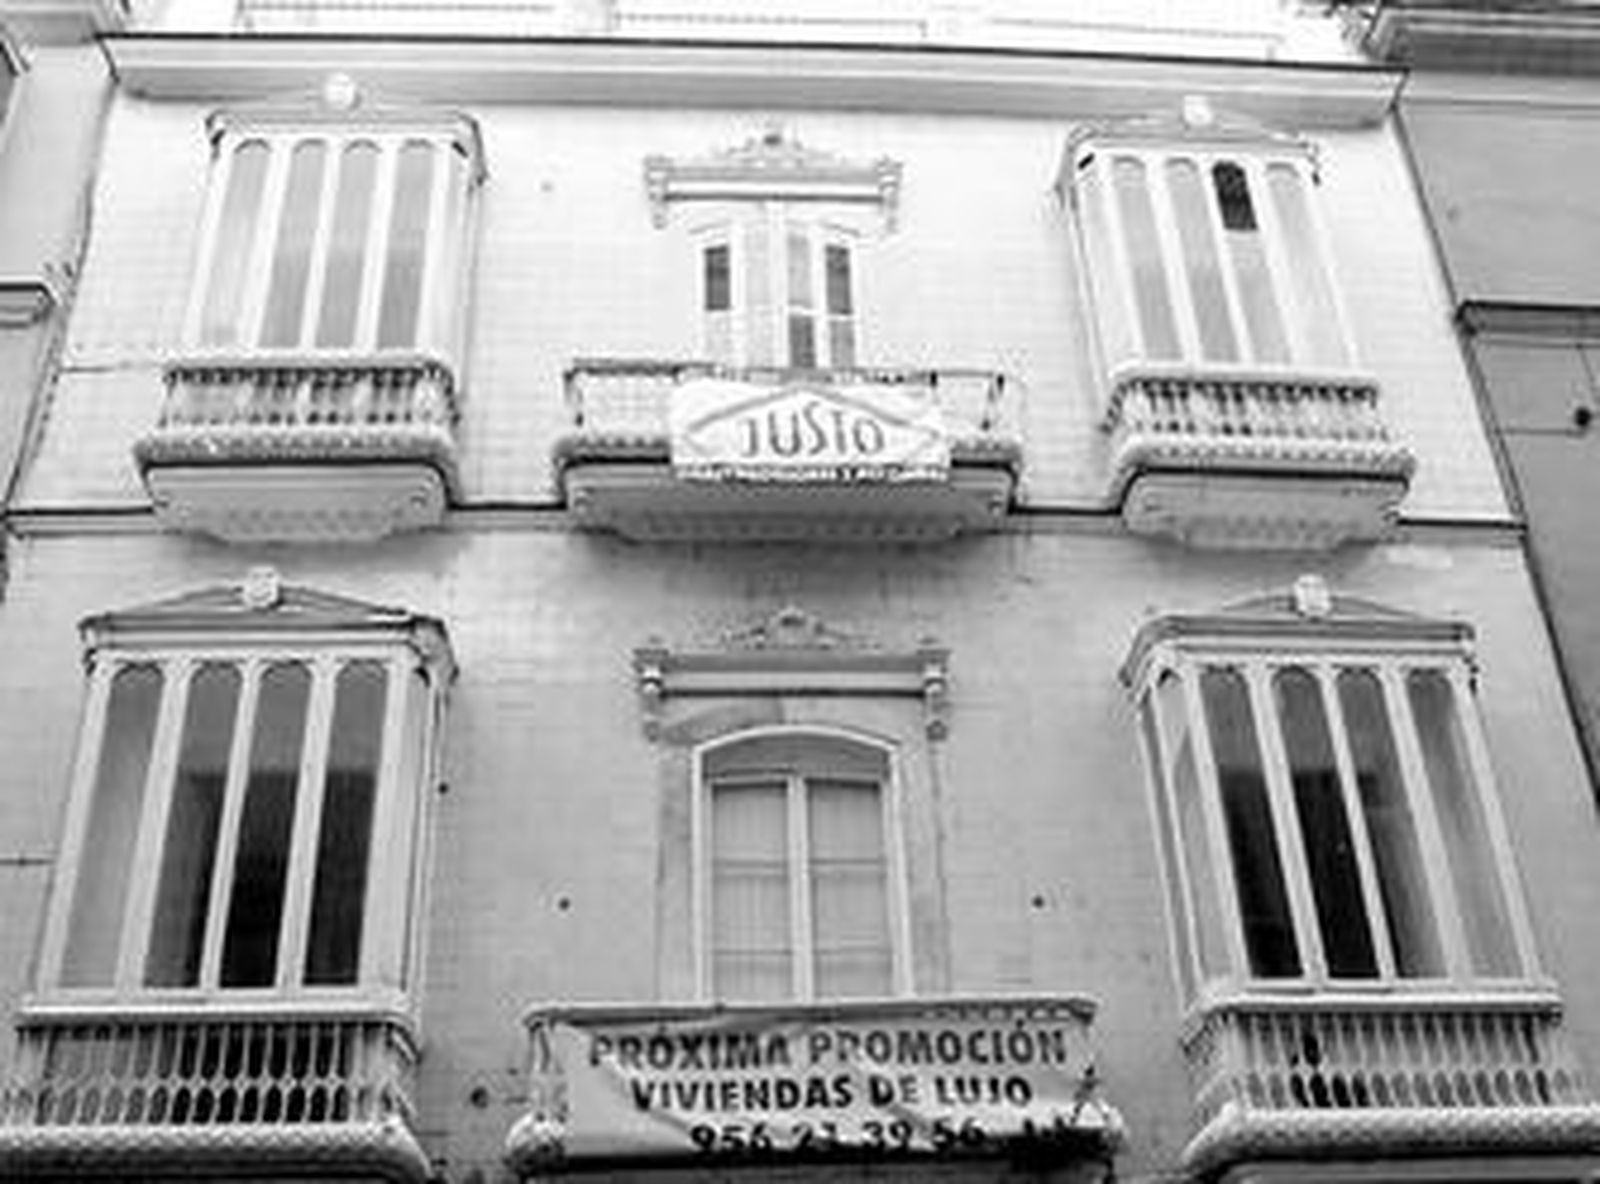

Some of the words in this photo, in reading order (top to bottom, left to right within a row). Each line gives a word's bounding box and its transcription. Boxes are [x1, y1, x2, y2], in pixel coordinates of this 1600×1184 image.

[590, 1024, 790, 1070] PRÓXIMA
[809, 1018, 1066, 1065] PROMOCIÓN
[632, 1075, 853, 1112] VIVIENDAS
[868, 1075, 920, 1106] DE
[935, 1075, 1032, 1106] LUJO
[690, 1122, 773, 1151] 956
